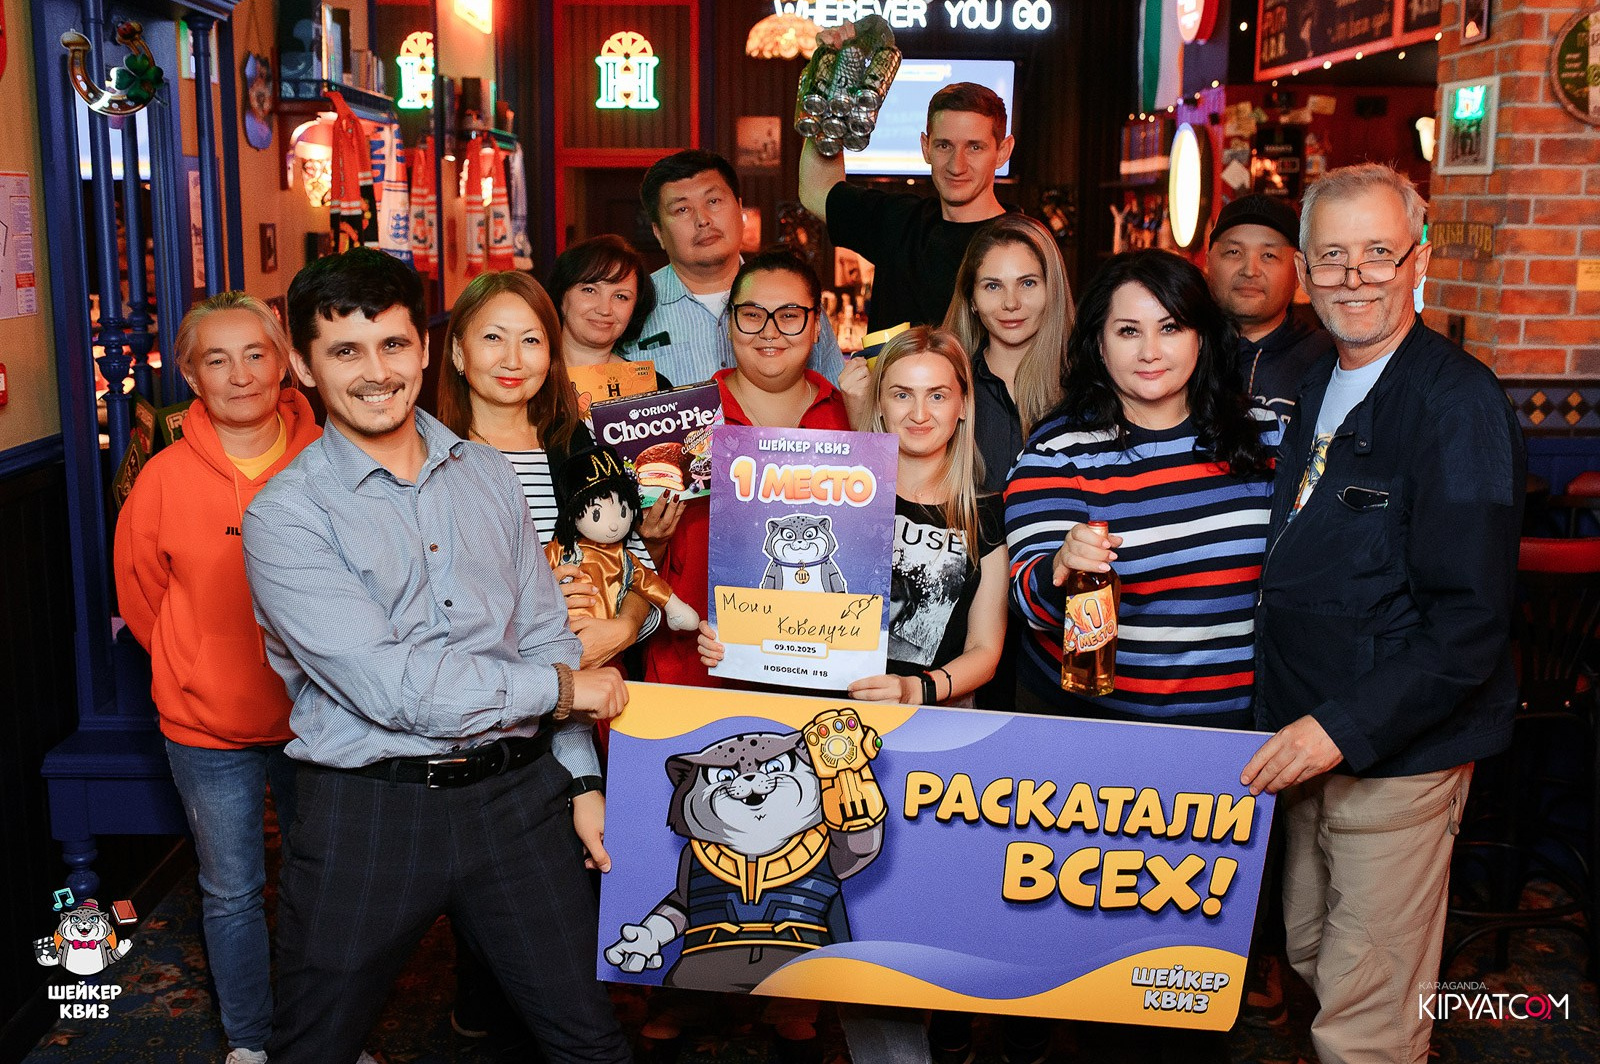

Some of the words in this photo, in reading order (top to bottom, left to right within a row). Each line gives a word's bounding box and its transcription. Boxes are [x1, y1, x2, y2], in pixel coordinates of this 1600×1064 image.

[774, 0, 928, 28] WHEREVER
[945, 0, 1003, 29] YOU
[1012, 0, 1052, 31] GO
[1467, 223, 1492, 252] PUB
[641, 404, 676, 417] ORION
[758, 437, 810, 453] ШЕЙКЕР
[815, 442, 850, 455] КВИЗ
[732, 458, 755, 499] 1
[760, 466, 875, 505] МЕСТО
[894, 520, 963, 556] USE
[1084, 598, 1102, 628] 1
[774, 643, 817, 654] 09.10.2025
[1079, 621, 1116, 649] МЕСТО
[904, 771, 1256, 844] РАСКАТАЛИ
[1002, 841, 1239, 917] ВСЕХ!
[1131, 965, 1230, 993] ШЕЙКЕР
[1143, 989, 1209, 1014] КВИЗ
